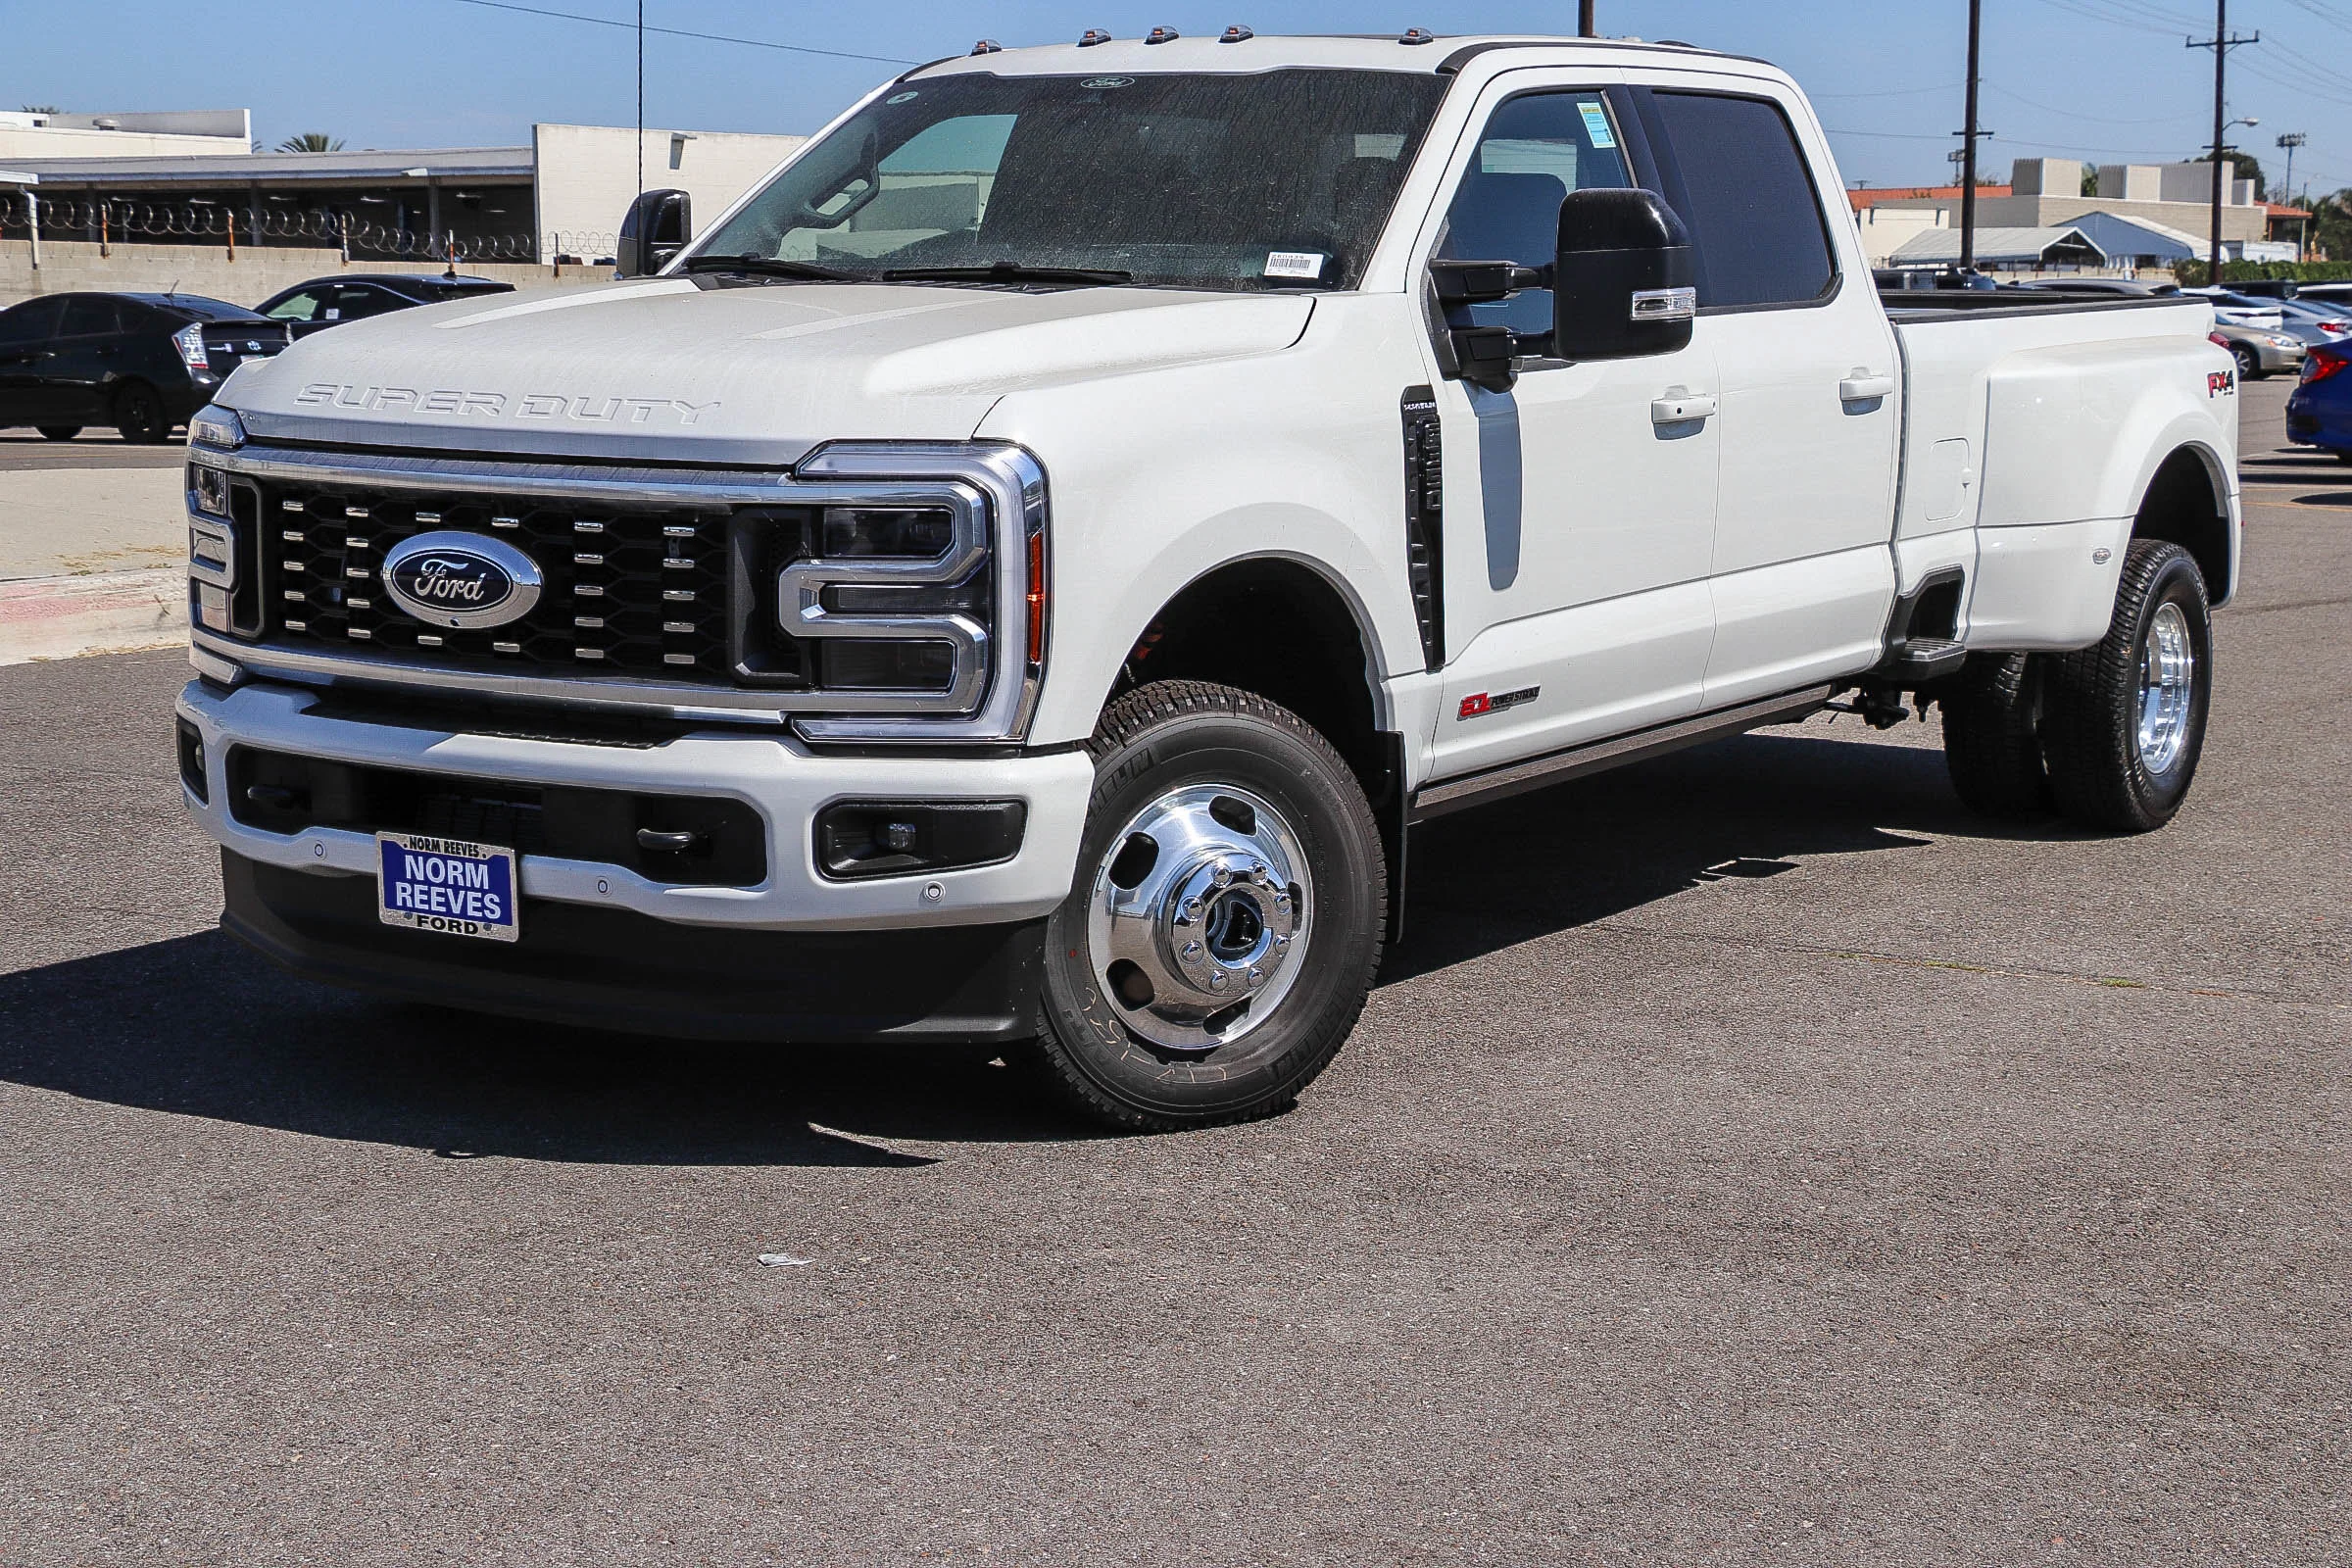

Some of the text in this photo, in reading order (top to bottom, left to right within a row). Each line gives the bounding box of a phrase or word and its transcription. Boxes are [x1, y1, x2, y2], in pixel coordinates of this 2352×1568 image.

[2207, 369, 2234, 398] FX4
[293, 383, 722, 425] SUPER DUTY
[415, 559, 487, 601] Ford
[409, 835, 480, 858] NORM REEVES
[405, 854, 489, 890] NORM
[395, 881, 502, 919] REEVES
[416, 914, 479, 935] FORD
